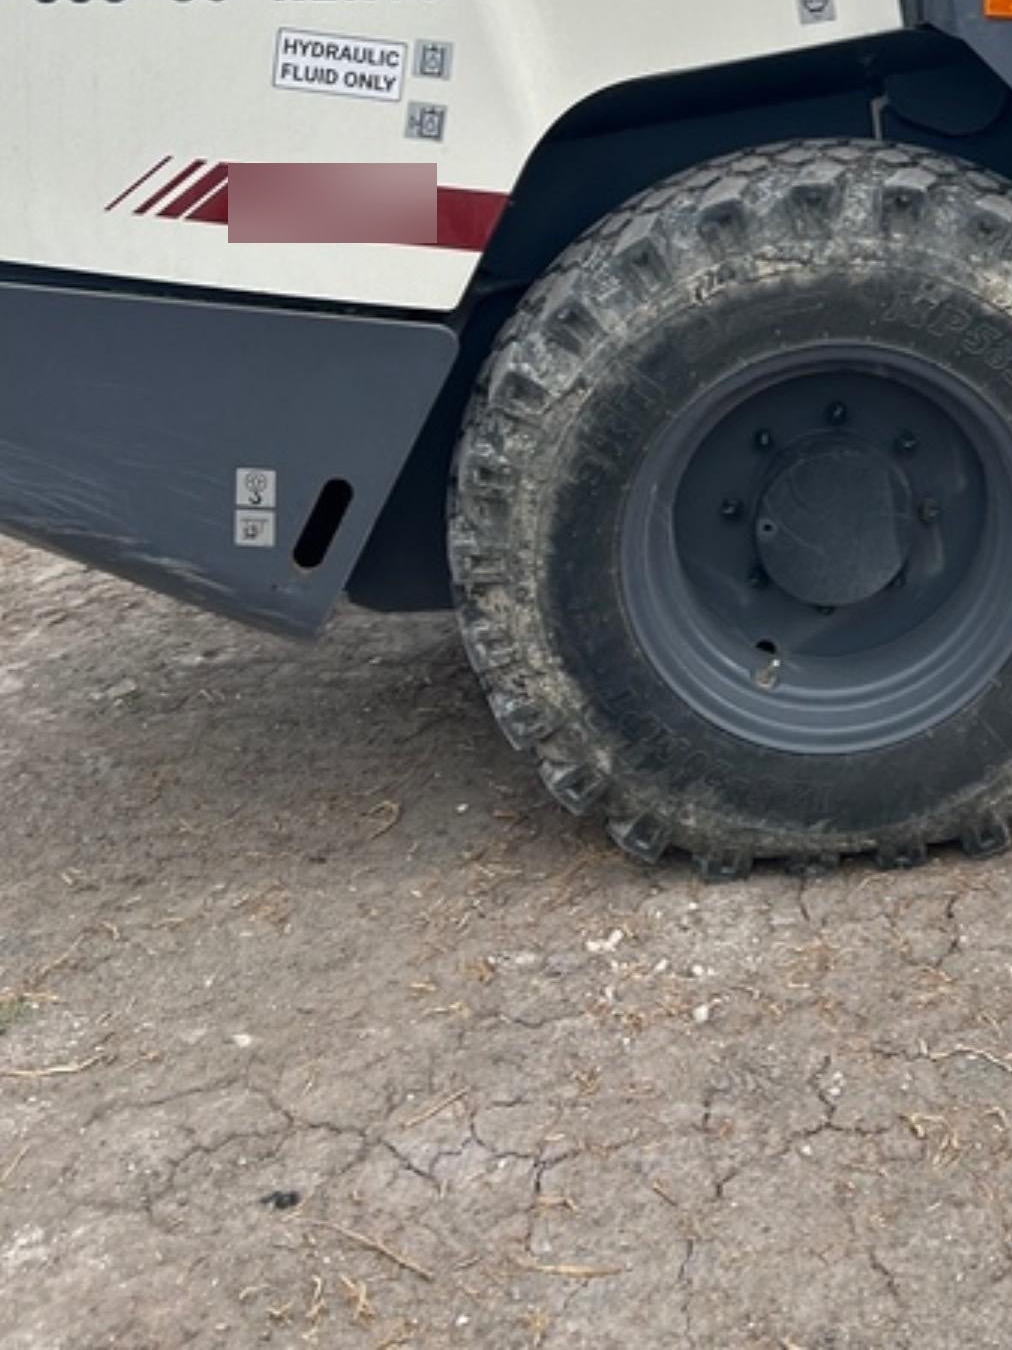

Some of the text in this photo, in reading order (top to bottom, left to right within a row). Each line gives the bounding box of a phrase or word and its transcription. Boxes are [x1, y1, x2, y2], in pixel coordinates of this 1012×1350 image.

[283, 38, 401, 67] HYDRAULIC
[281, 63, 397, 92] FLUID ONLY
